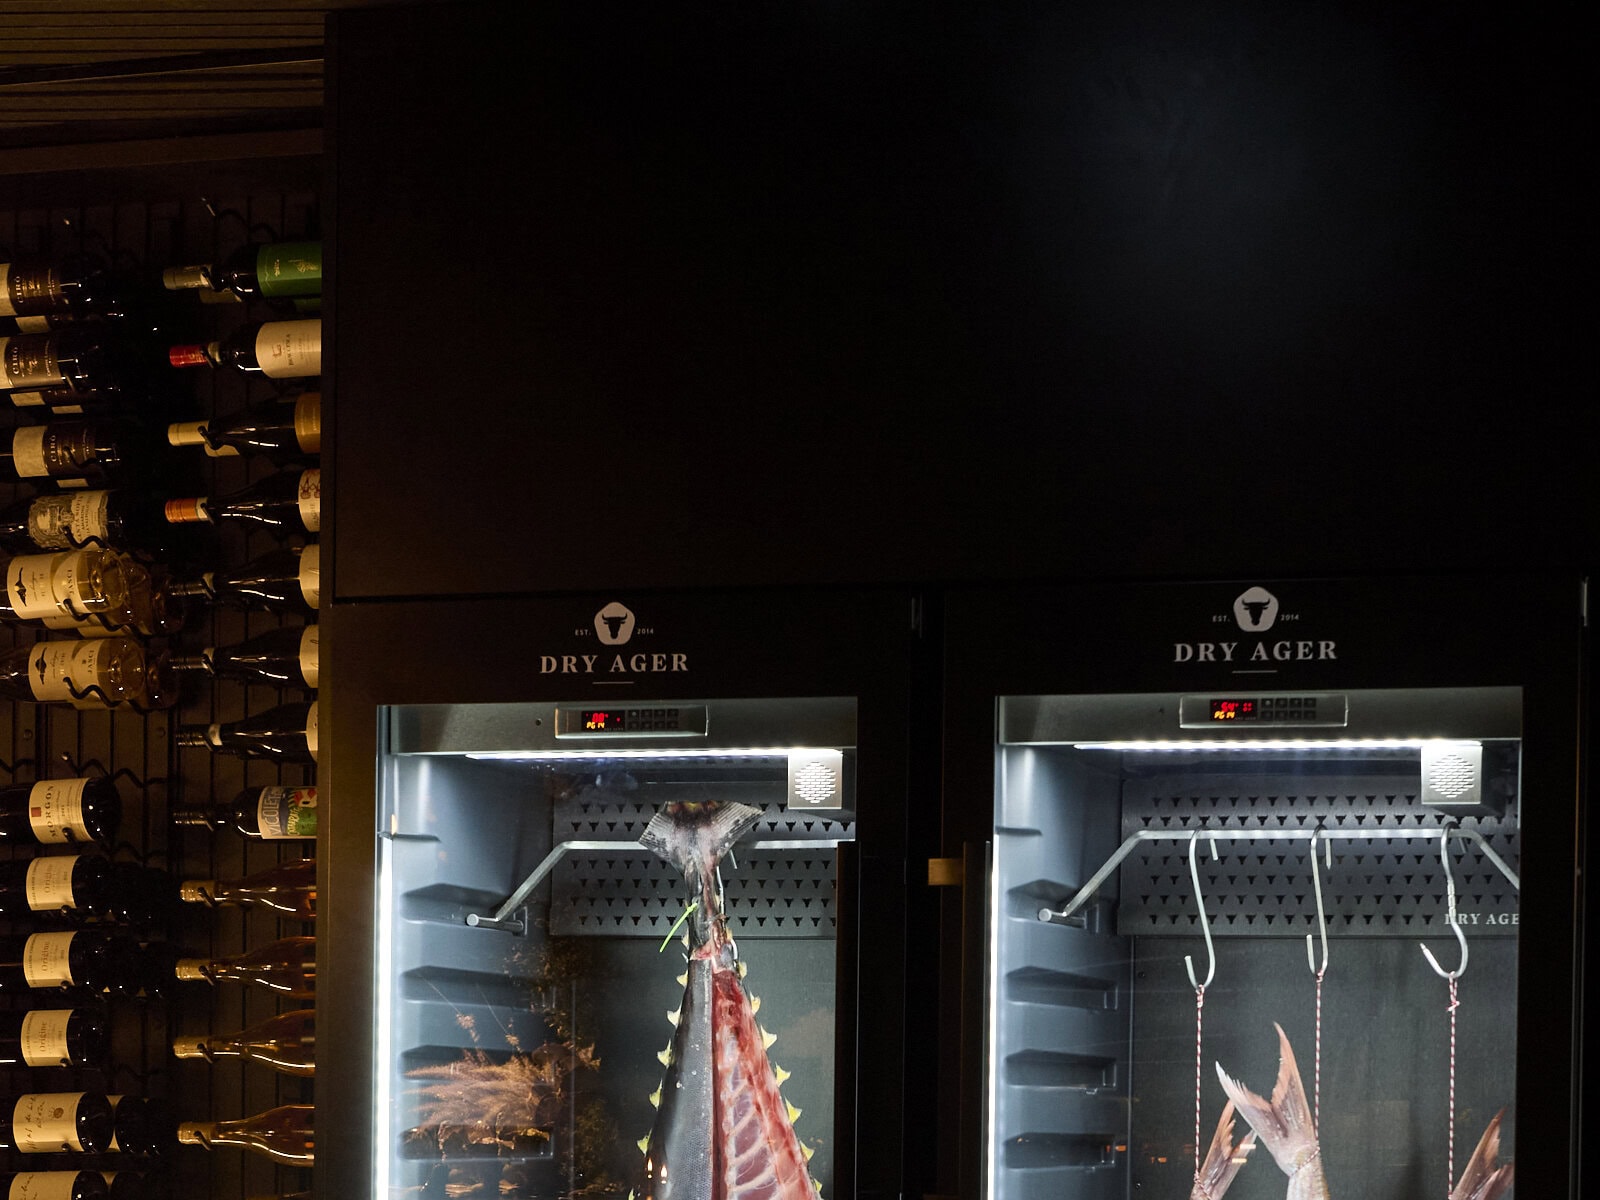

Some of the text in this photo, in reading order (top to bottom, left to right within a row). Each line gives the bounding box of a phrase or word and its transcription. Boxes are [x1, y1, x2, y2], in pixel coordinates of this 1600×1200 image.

[67, 568, 75, 595] JASCI
[87, 650, 95, 675] JASCI
[539, 653, 689, 674] DRY AGER
[1173, 640, 1338, 663] DRY AGER
[44, 785, 57, 838] MORGON
[1485, 913, 1520, 925] AGE
